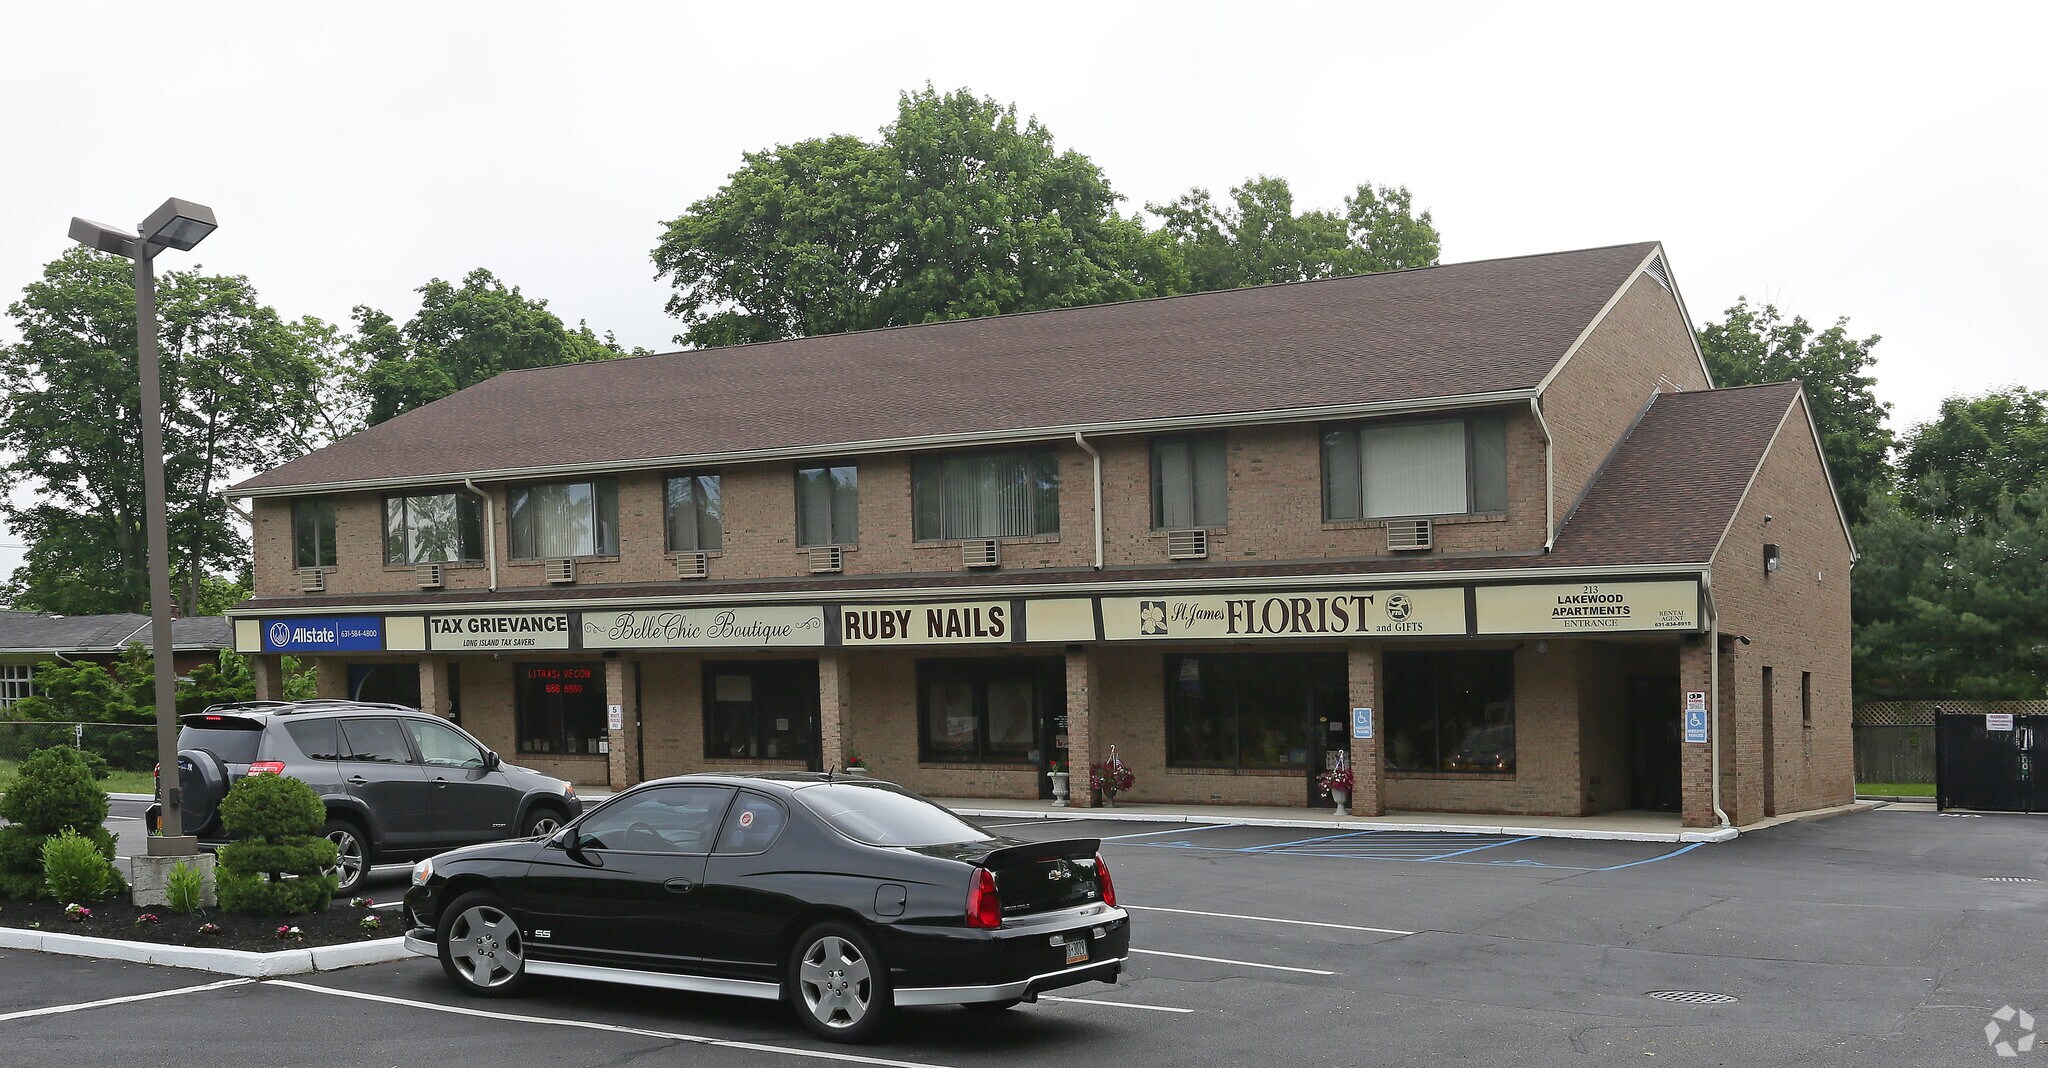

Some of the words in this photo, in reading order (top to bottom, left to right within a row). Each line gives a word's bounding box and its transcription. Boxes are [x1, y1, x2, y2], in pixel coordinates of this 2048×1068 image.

[1583, 585, 1598, 594] 213
[1557, 594, 1624, 605] LAKEWOOD
[1225, 594, 1375, 635] FLORIST
[1551, 605, 1631, 616] APARTMENTS
[431, 618, 462, 634] TAX
[467, 616, 567, 633] GRIEVANCE
[706, 608, 793, 644] Boutique
[844, 609, 912, 640] RUBY
[926, 605, 1006, 638] NAILS
[1375, 622, 1392, 632] and
[1394, 621, 1424, 632] GIFTS
[1563, 618, 1618, 628] ENTRANCE
[291, 627, 335, 644] Allstate
[340, 629, 378, 638] 631-584-4800
[463, 638, 478, 647] LONG
[478, 638, 500, 647] ISLAND
[501, 638, 513, 646] TAX
[513, 637, 535, 646] SAVERS
[534, 929, 551, 938] SS
